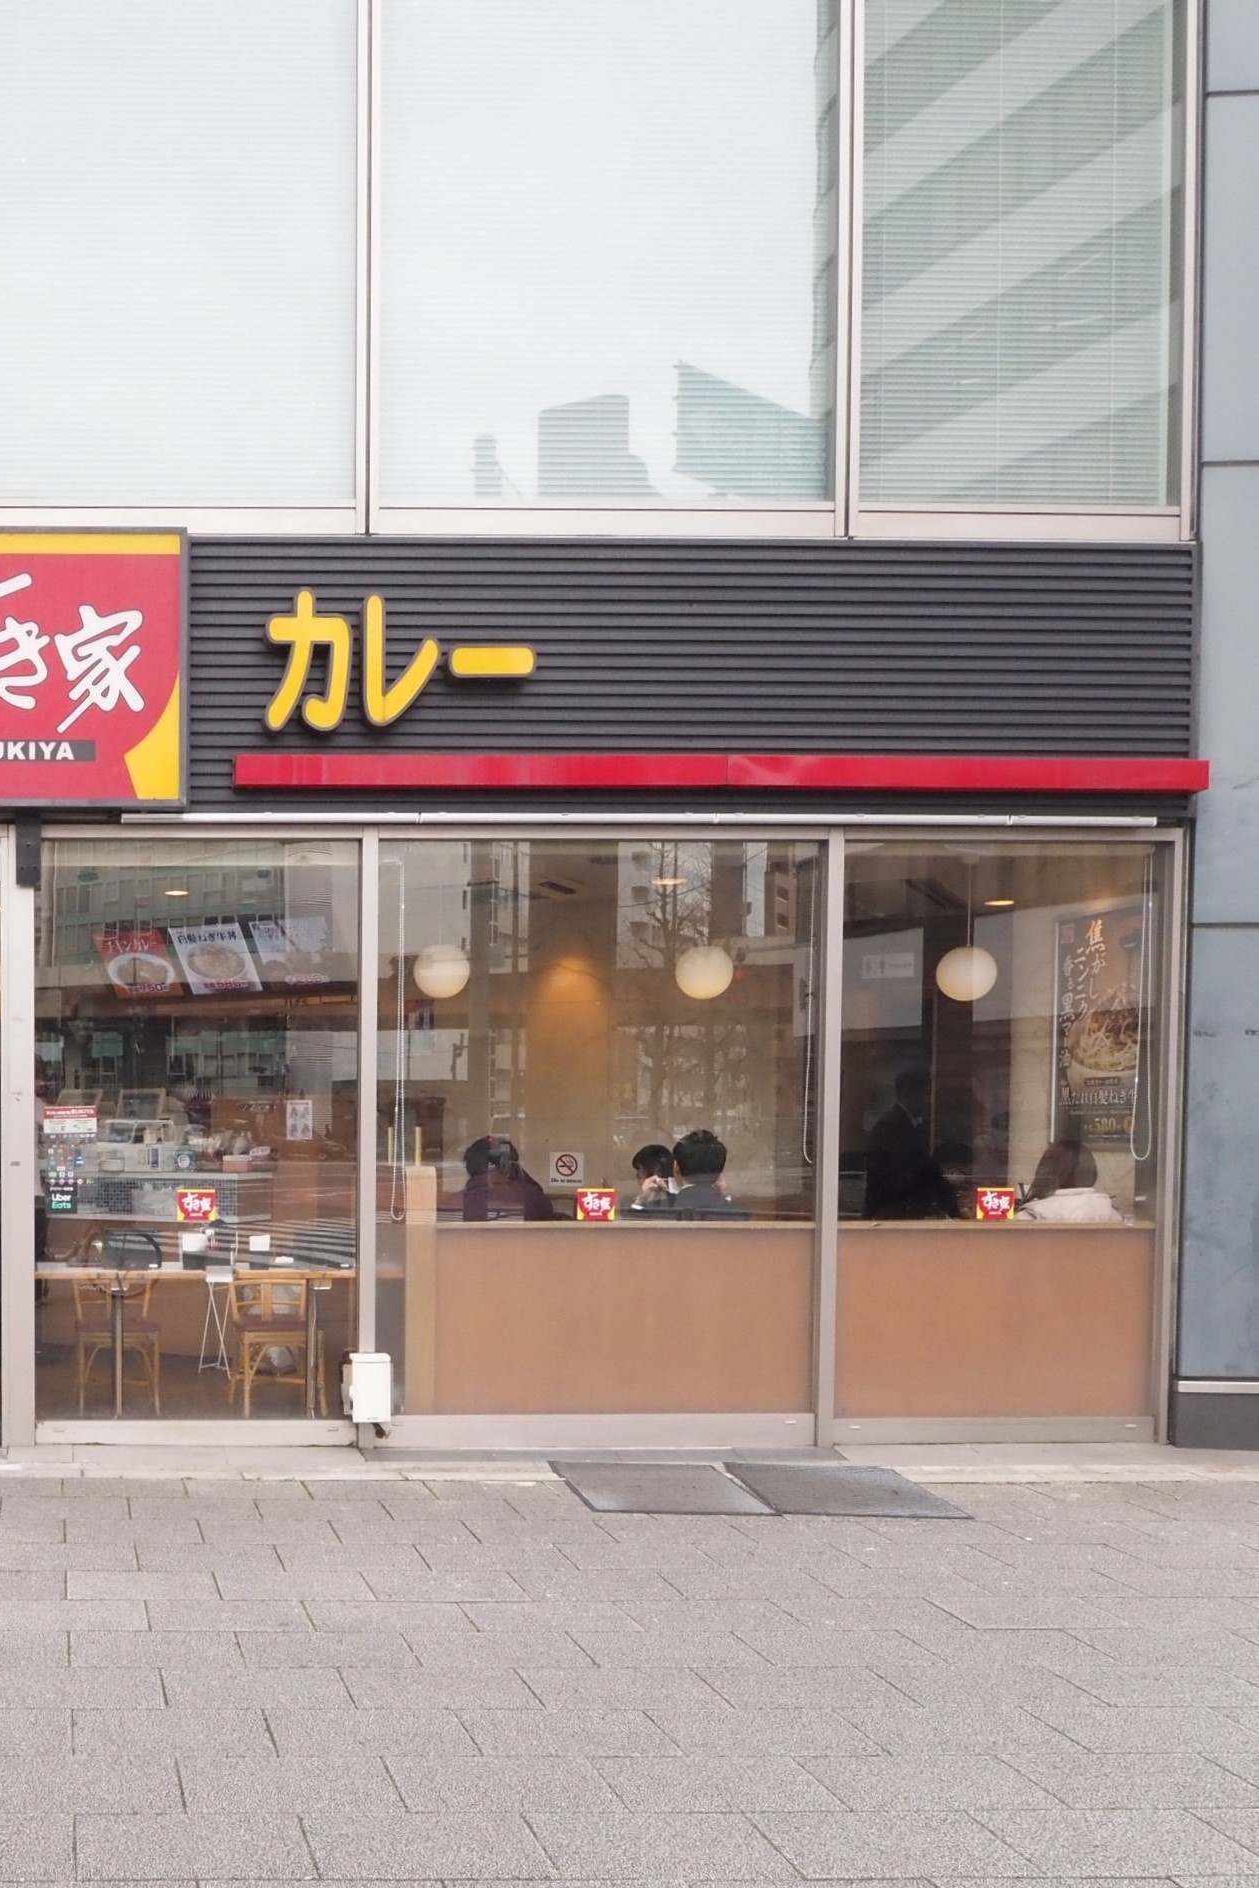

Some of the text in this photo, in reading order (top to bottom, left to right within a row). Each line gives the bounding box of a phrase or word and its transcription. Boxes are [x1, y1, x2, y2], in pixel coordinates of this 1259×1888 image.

[264, 588, 537, 734] カレー
[51, 1192, 72, 1202] Uber
[51, 1201, 72, 1210] Eats
